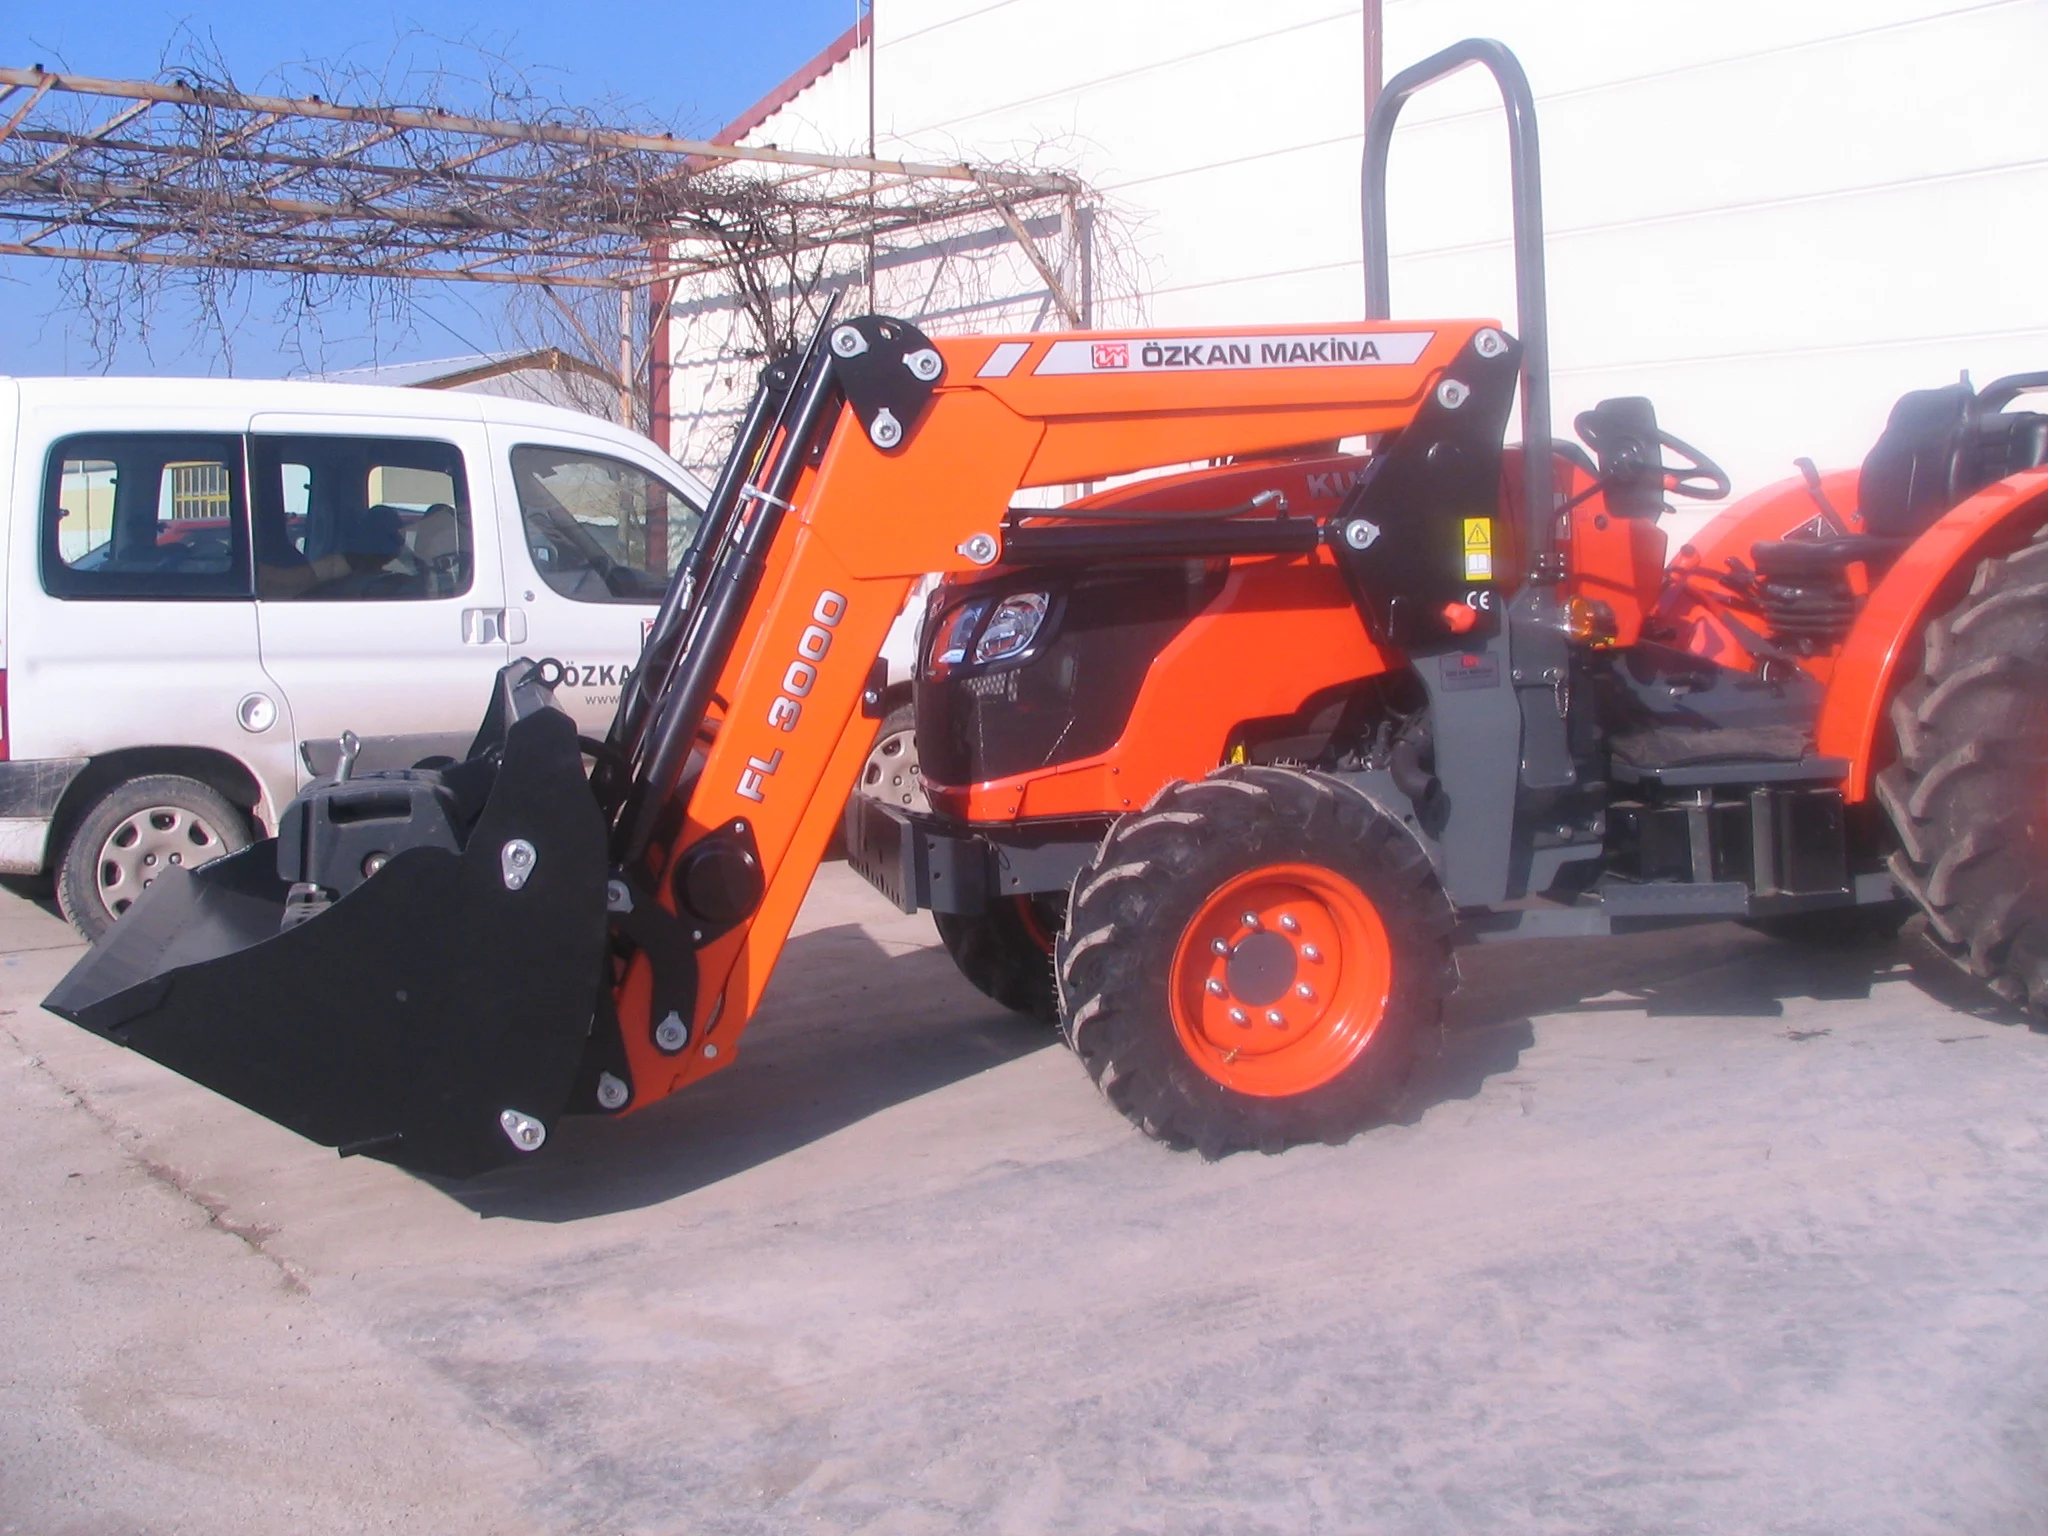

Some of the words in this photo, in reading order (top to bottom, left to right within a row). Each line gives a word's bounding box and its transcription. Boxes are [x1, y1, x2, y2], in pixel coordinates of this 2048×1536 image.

[1142, 341, 1251, 368] ÖZKAN
[1260, 337, 1381, 364] MAKİNA
[1466, 590, 1490, 610] CE
[735, 748, 785, 804] FL
[766, 588, 848, 733] 3000
